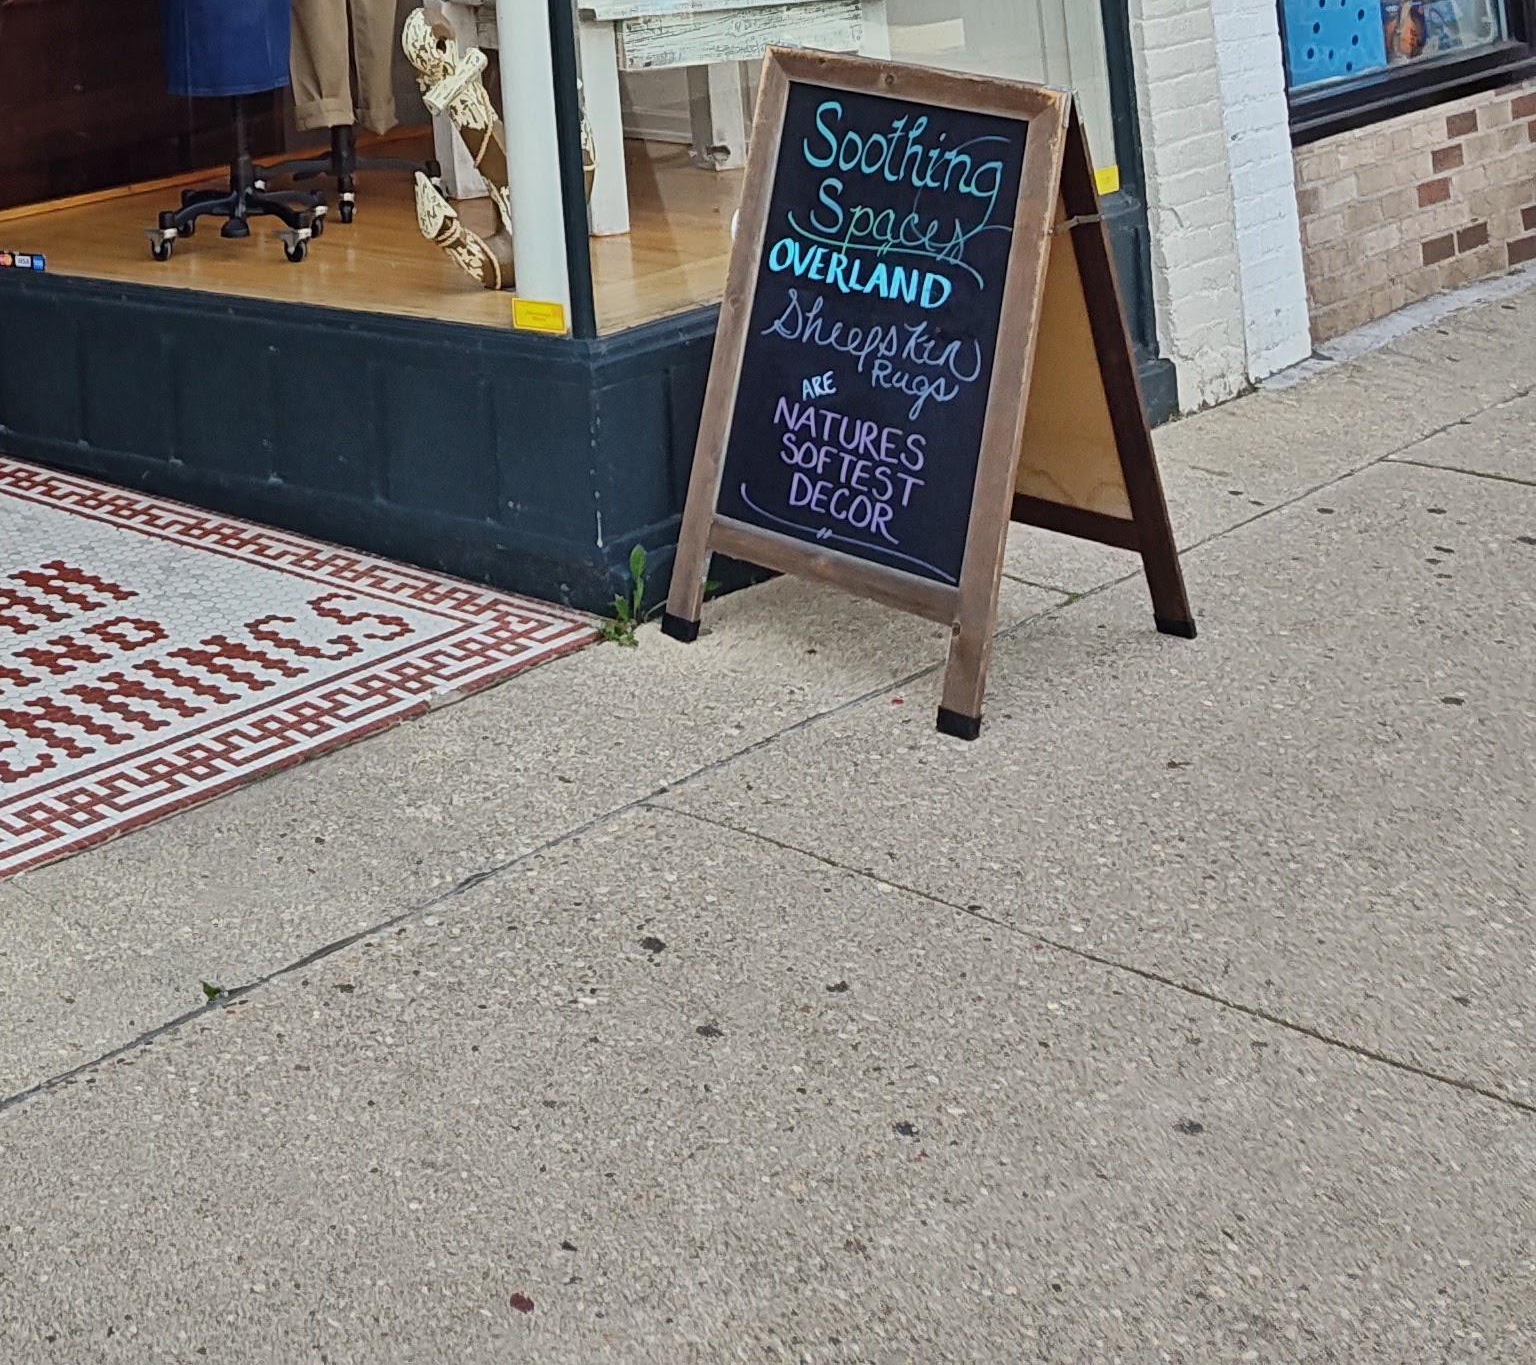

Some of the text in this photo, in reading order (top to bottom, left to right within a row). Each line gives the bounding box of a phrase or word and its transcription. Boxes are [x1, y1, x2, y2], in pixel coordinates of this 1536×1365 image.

[803, 100, 1005, 219] Soothing
[809, 177, 965, 265] Spaces
[768, 237, 952, 309] OVERLAND
[801, 370, 837, 401] ARE
[871, 359, 959, 421] Rugs
[773, 396, 927, 472] NATURES
[779, 433, 925, 508] SOFTEST
[788, 473, 899, 545] DECOR
